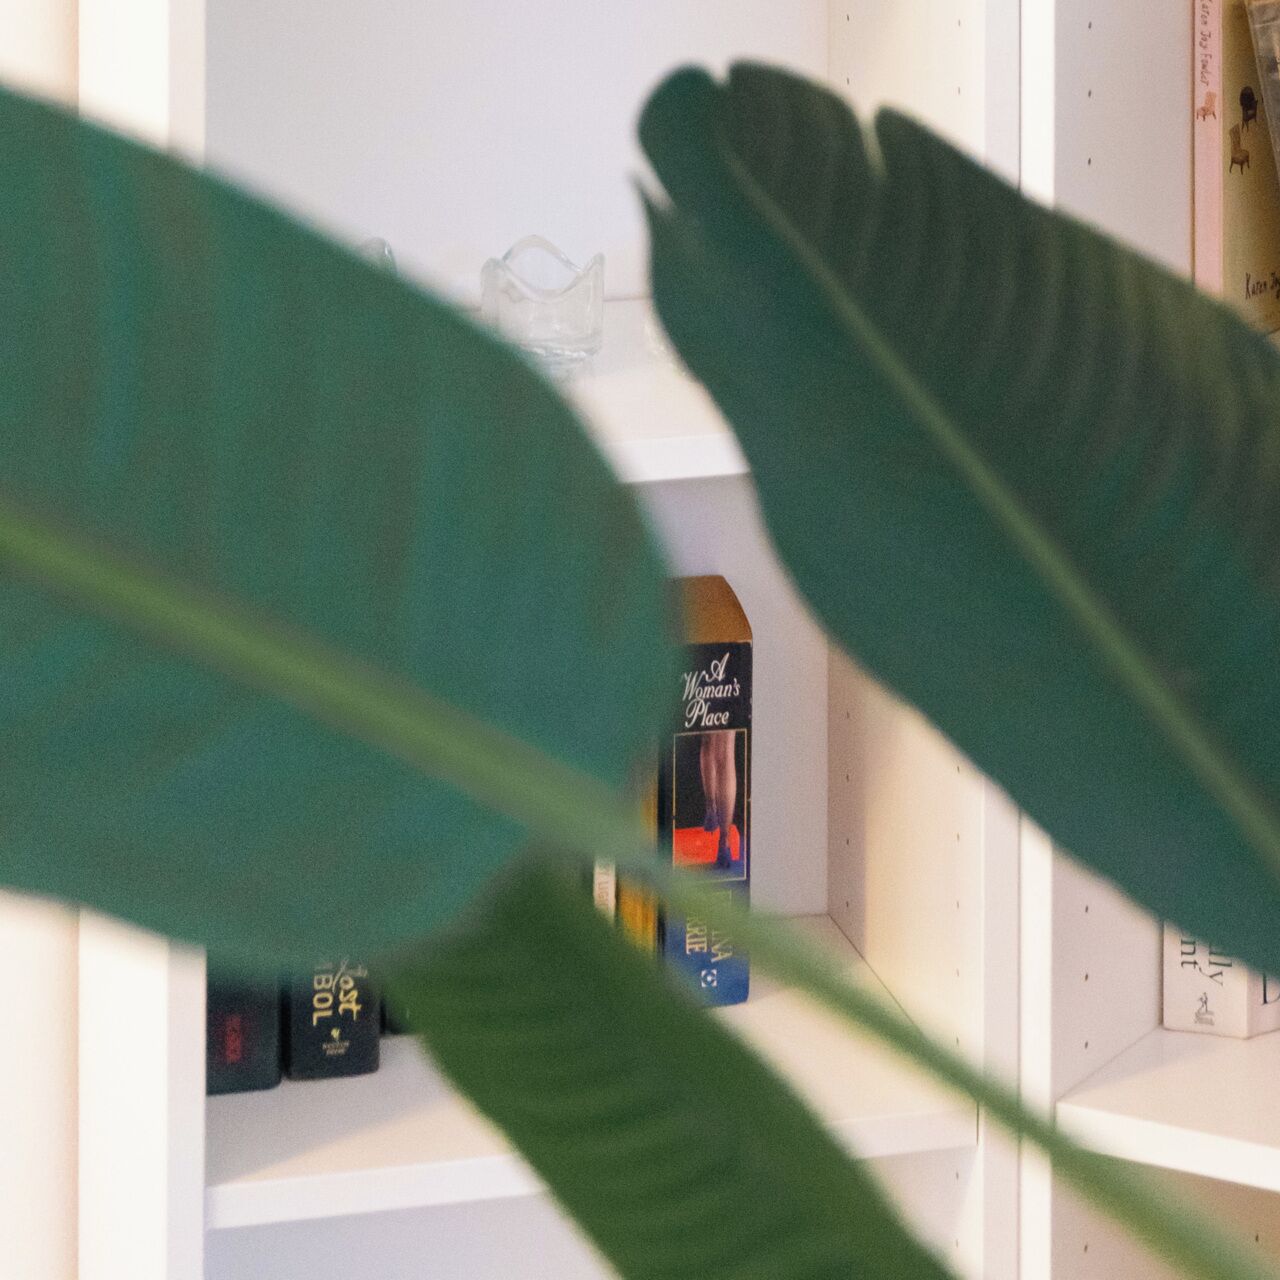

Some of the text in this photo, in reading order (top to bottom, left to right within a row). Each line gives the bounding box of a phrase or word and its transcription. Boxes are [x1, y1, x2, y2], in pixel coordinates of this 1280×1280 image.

[1198, 31, 1212, 49] Jay
[1200, 52, 1213, 87] Fowler
[706, 651, 730, 682] A
[682, 670, 741, 701] Woman's
[684, 698, 730, 728] Place
